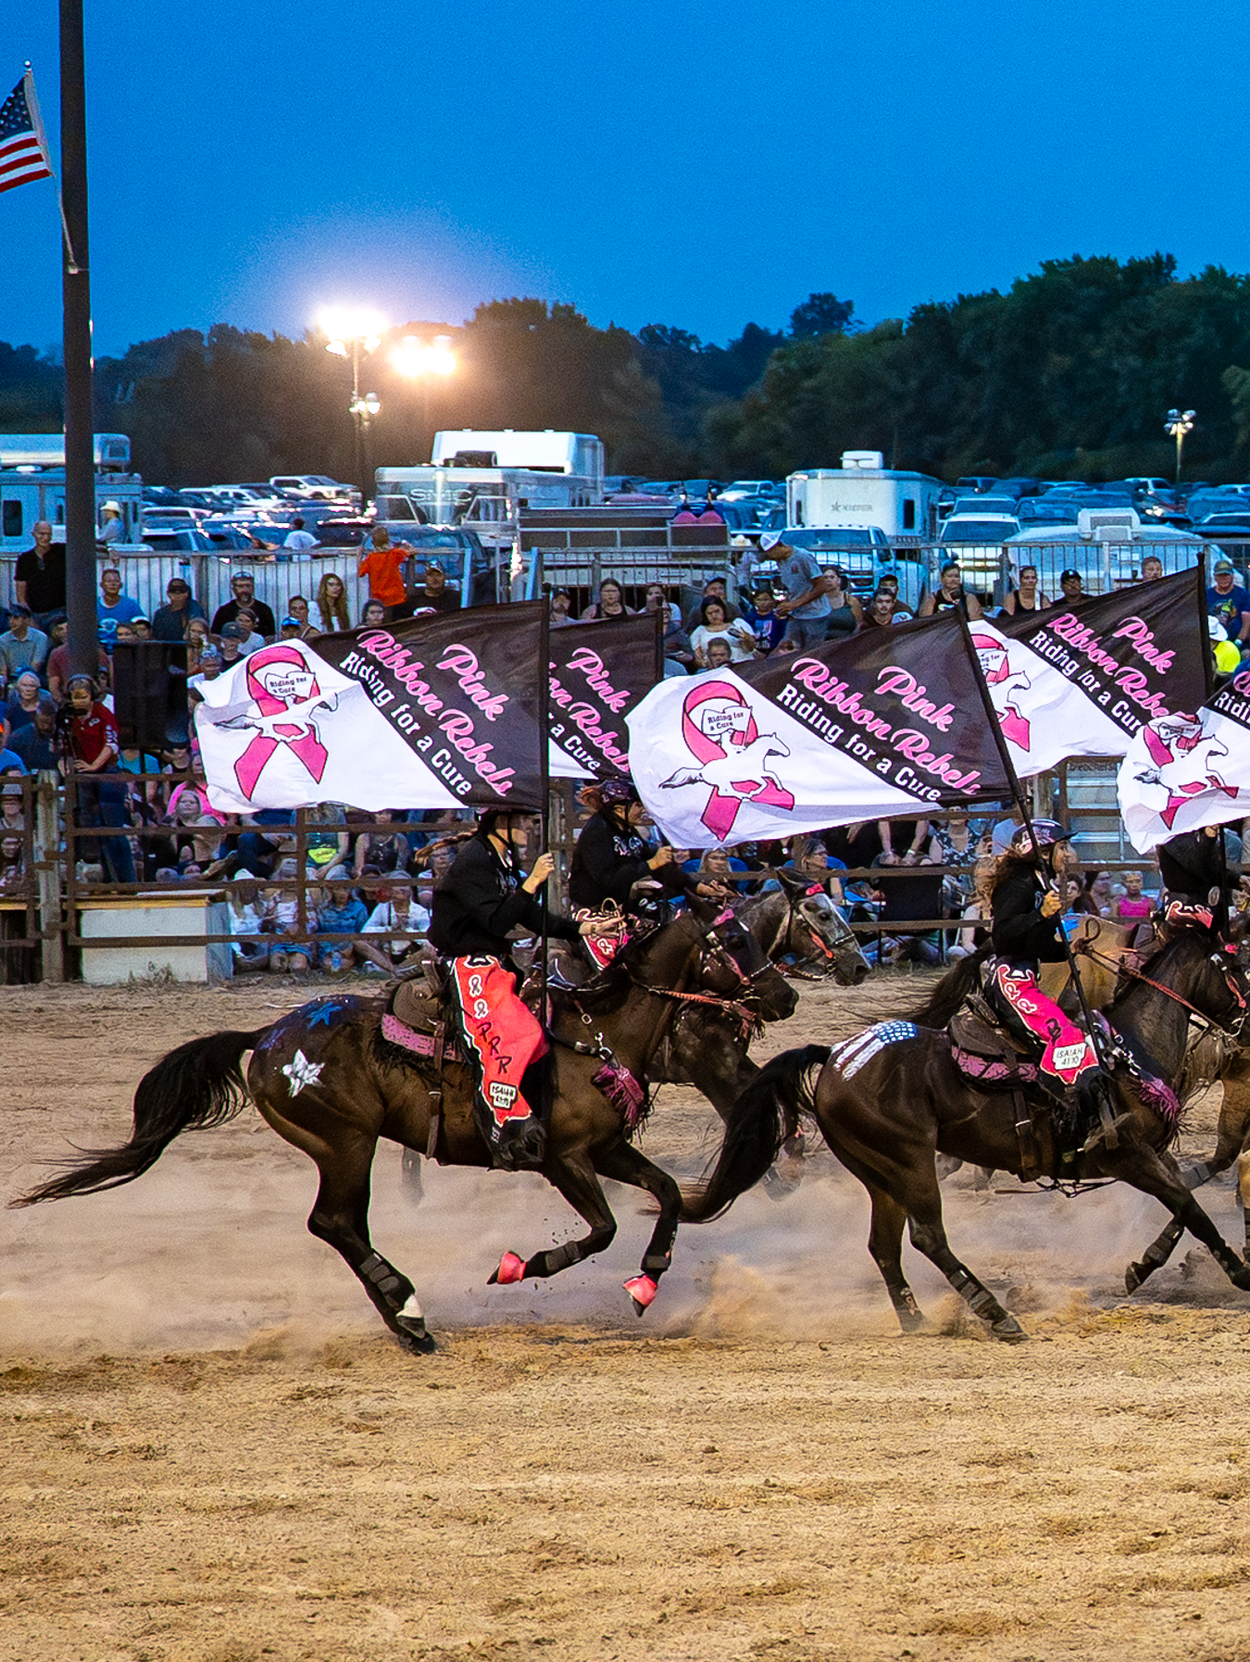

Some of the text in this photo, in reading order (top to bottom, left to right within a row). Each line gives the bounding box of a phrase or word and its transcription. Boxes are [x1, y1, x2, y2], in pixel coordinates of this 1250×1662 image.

[435, 643, 510, 722] Pink
[565, 646, 631, 714] Pink
[1029, 630, 1080, 677] Riding
[1097, 691, 1112, 706] a
[1111, 700, 1142, 732] Cur
[1046, 613, 1170, 718] Ribbon Rebe
[1112, 615, 1177, 675] Pink
[339, 651, 472, 796] Riding for a Cure
[356, 629, 516, 797] Ribbon Rebels
[567, 701, 630, 773] Rebel
[790, 657, 982, 797] Ribbon Rebels
[876, 666, 955, 733] Pink
[550, 723, 602, 771] a Cure
[775, 683, 942, 802] Riding for a Cure
[1056, 1047, 1083, 1059] ISAIAH
